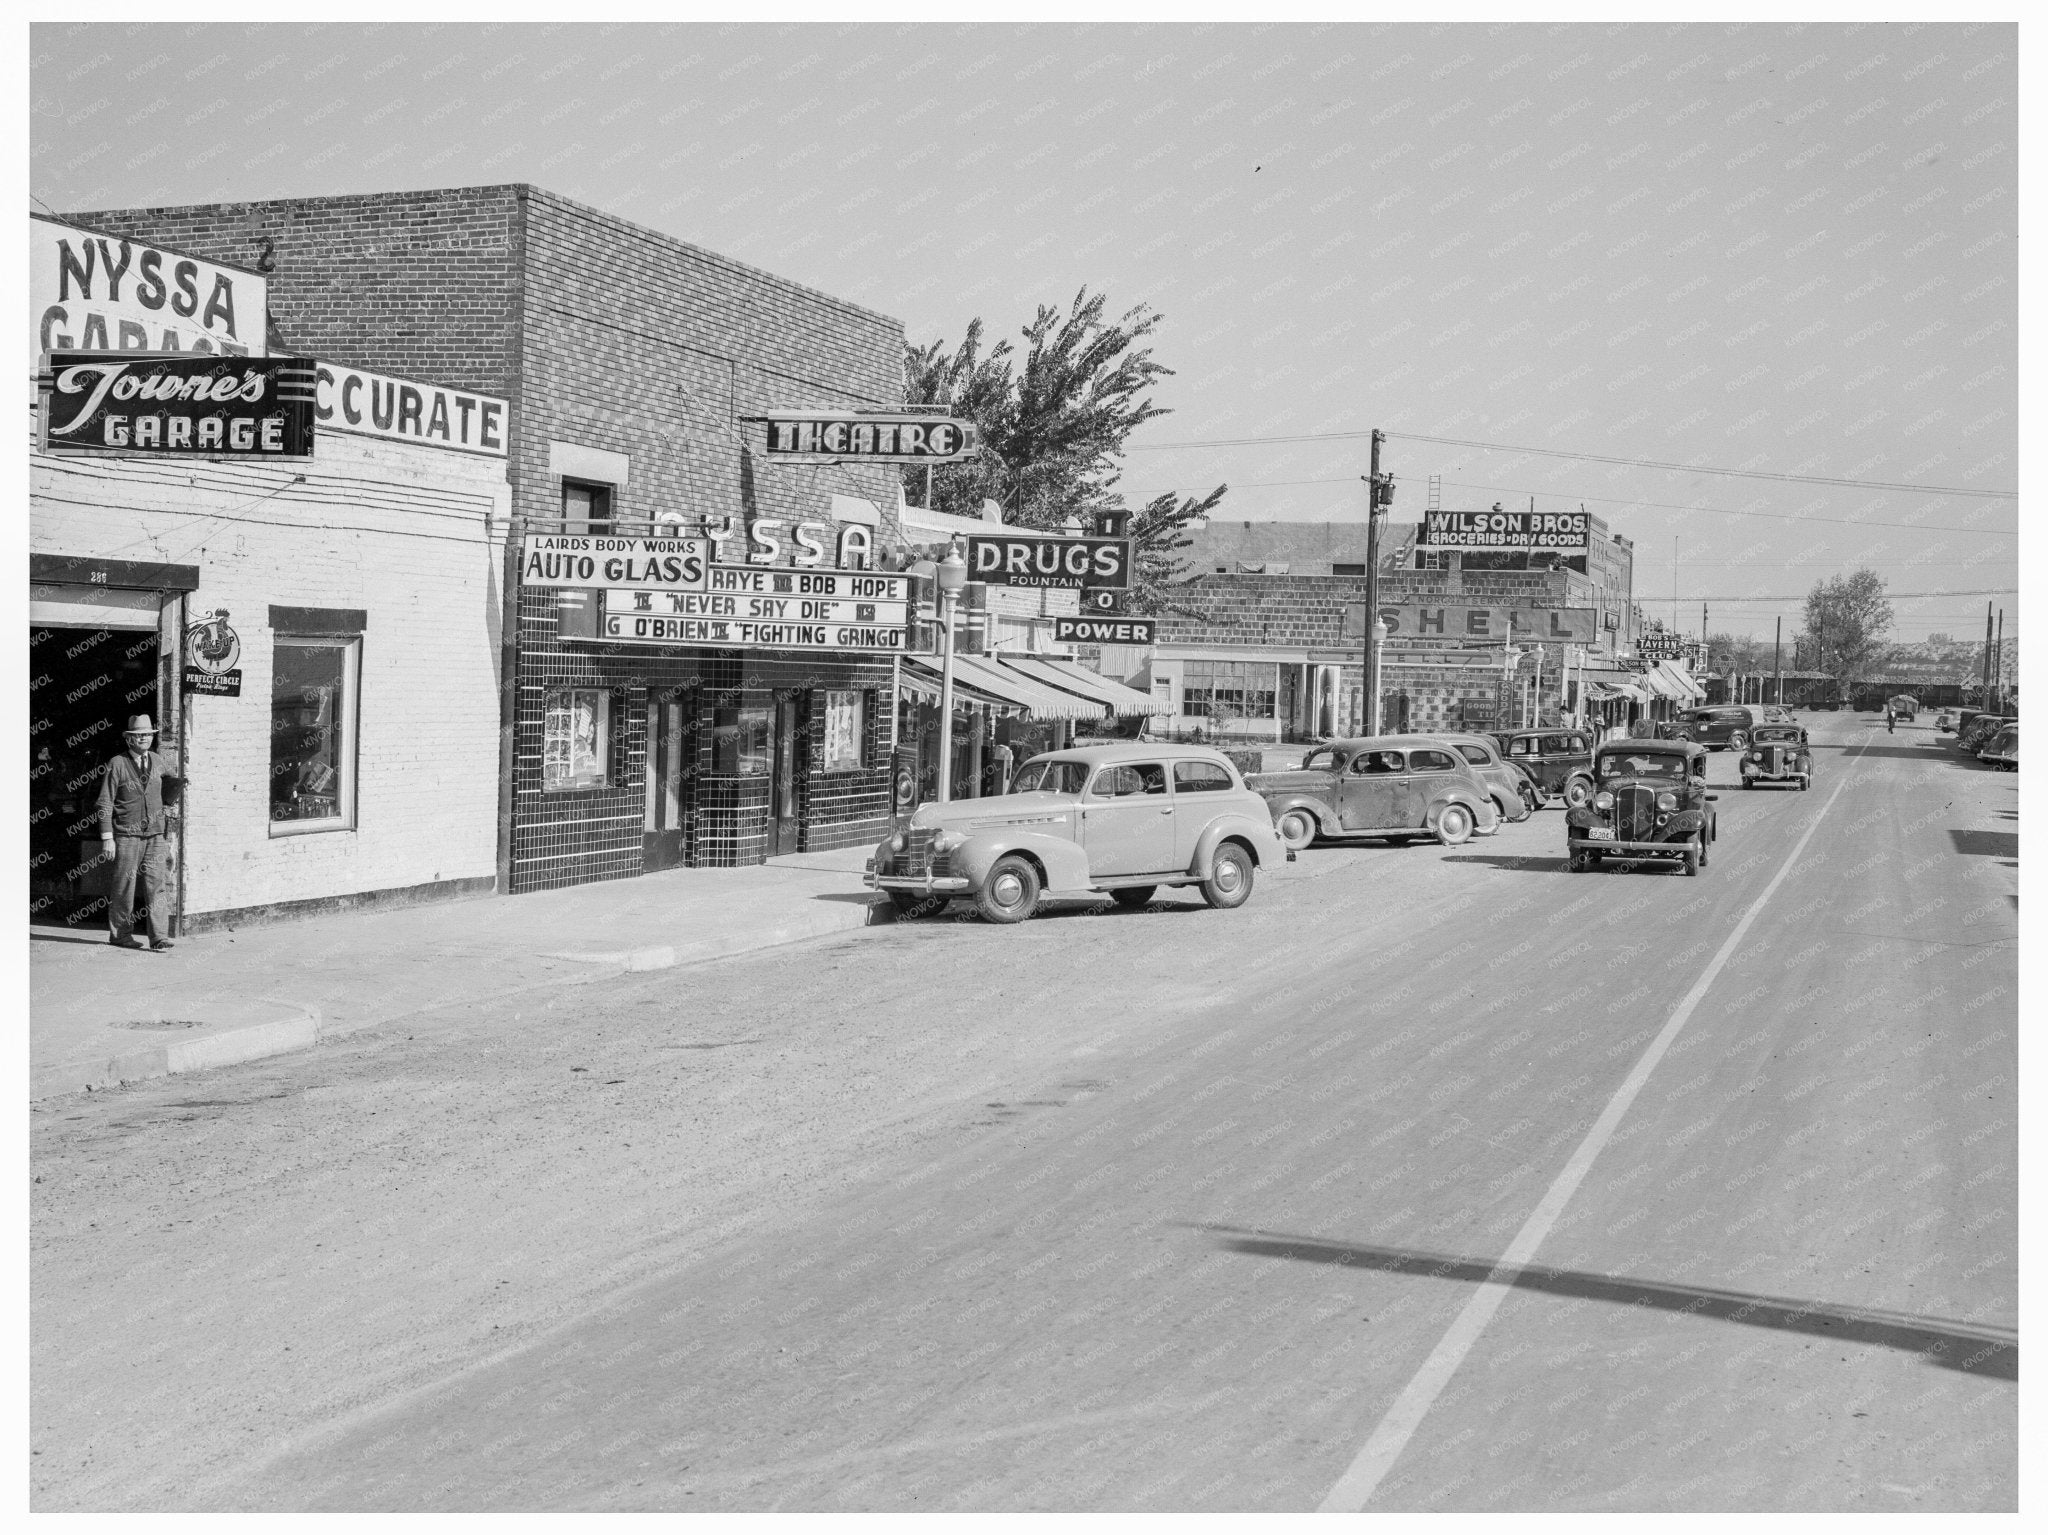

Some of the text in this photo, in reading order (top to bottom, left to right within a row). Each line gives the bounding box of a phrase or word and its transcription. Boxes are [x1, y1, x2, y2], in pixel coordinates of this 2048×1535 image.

[57, 239, 238, 341] NYSSA
[50, 363, 266, 434] Towne's
[314, 368, 501, 449] CCURATE
[104, 416, 283, 450] GARAGE
[774, 422, 954, 456] THEATRE
[1429, 514, 1522, 532] WILSON
[535, 537, 696, 554] LAIRD'S BODY WORKS
[1538, 533, 1584, 546] GOODS
[526, 551, 702, 583] AUTO GLASS
[976, 542, 1120, 577] DRUGS
[712, 569, 764, 592] RAYE
[800, 575, 835, 595] BOB
[851, 577, 898, 597] HOPE
[1009, 575, 1084, 588] FOUNTAIN
[750, 598, 788, 618] SAY
[607, 616, 621, 635] G
[635, 617, 711, 640] O'BRIEN
[1059, 622, 1148, 641] POWER
[1377, 606, 1573, 638] SHELL
[195, 636, 235, 653] WAKE UP
[1640, 639, 1677, 650] TAVERN
[1346, 653, 1453, 664] SELL
[186, 674, 240, 686] PERFECT CIRCLE
